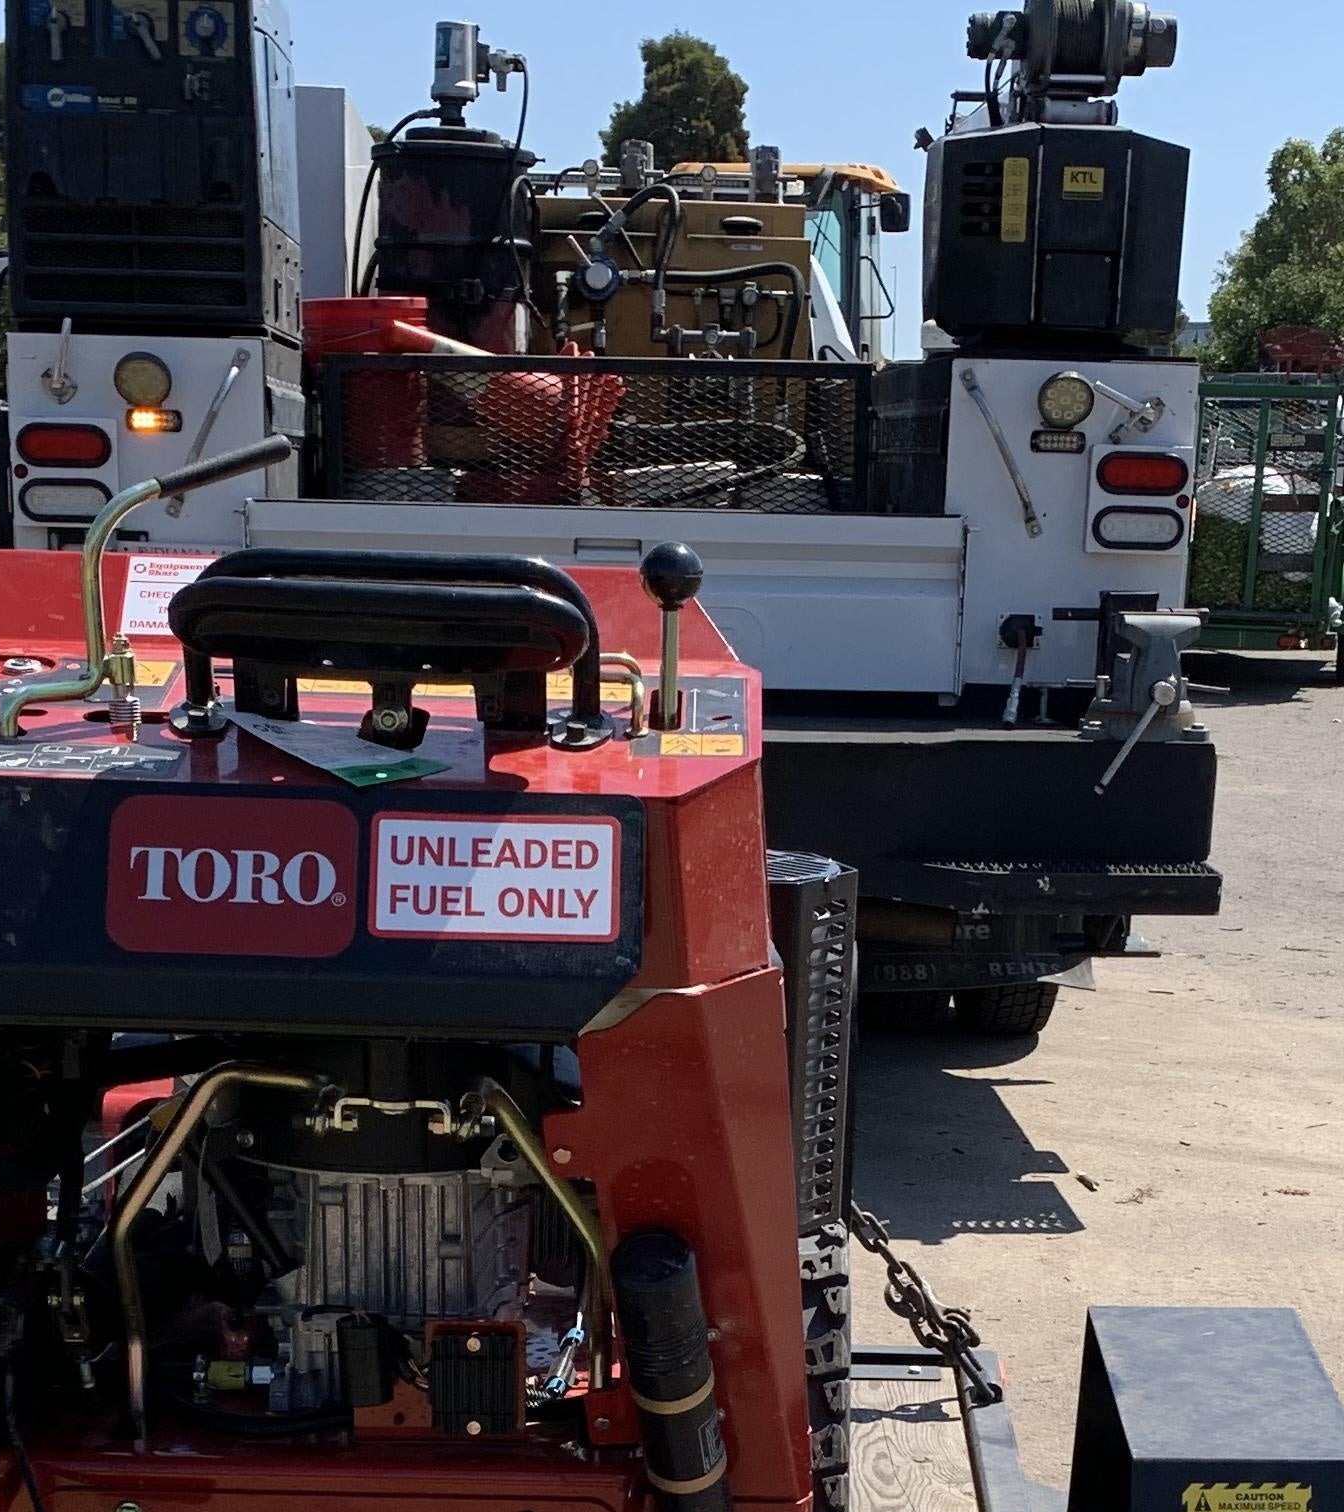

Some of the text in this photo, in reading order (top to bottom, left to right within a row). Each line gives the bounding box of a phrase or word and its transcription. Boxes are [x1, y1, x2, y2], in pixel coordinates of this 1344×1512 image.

[1070, 171, 1098, 184] KTL
[390, 835, 600, 870] UNLEADED
[130, 846, 337, 906] TORO
[390, 884, 599, 919] FUEL ONLY
[1218, 1502, 1302, 1511] MAXIMUM SPEED
[1235, 1493, 1285, 1501] CAUTION
